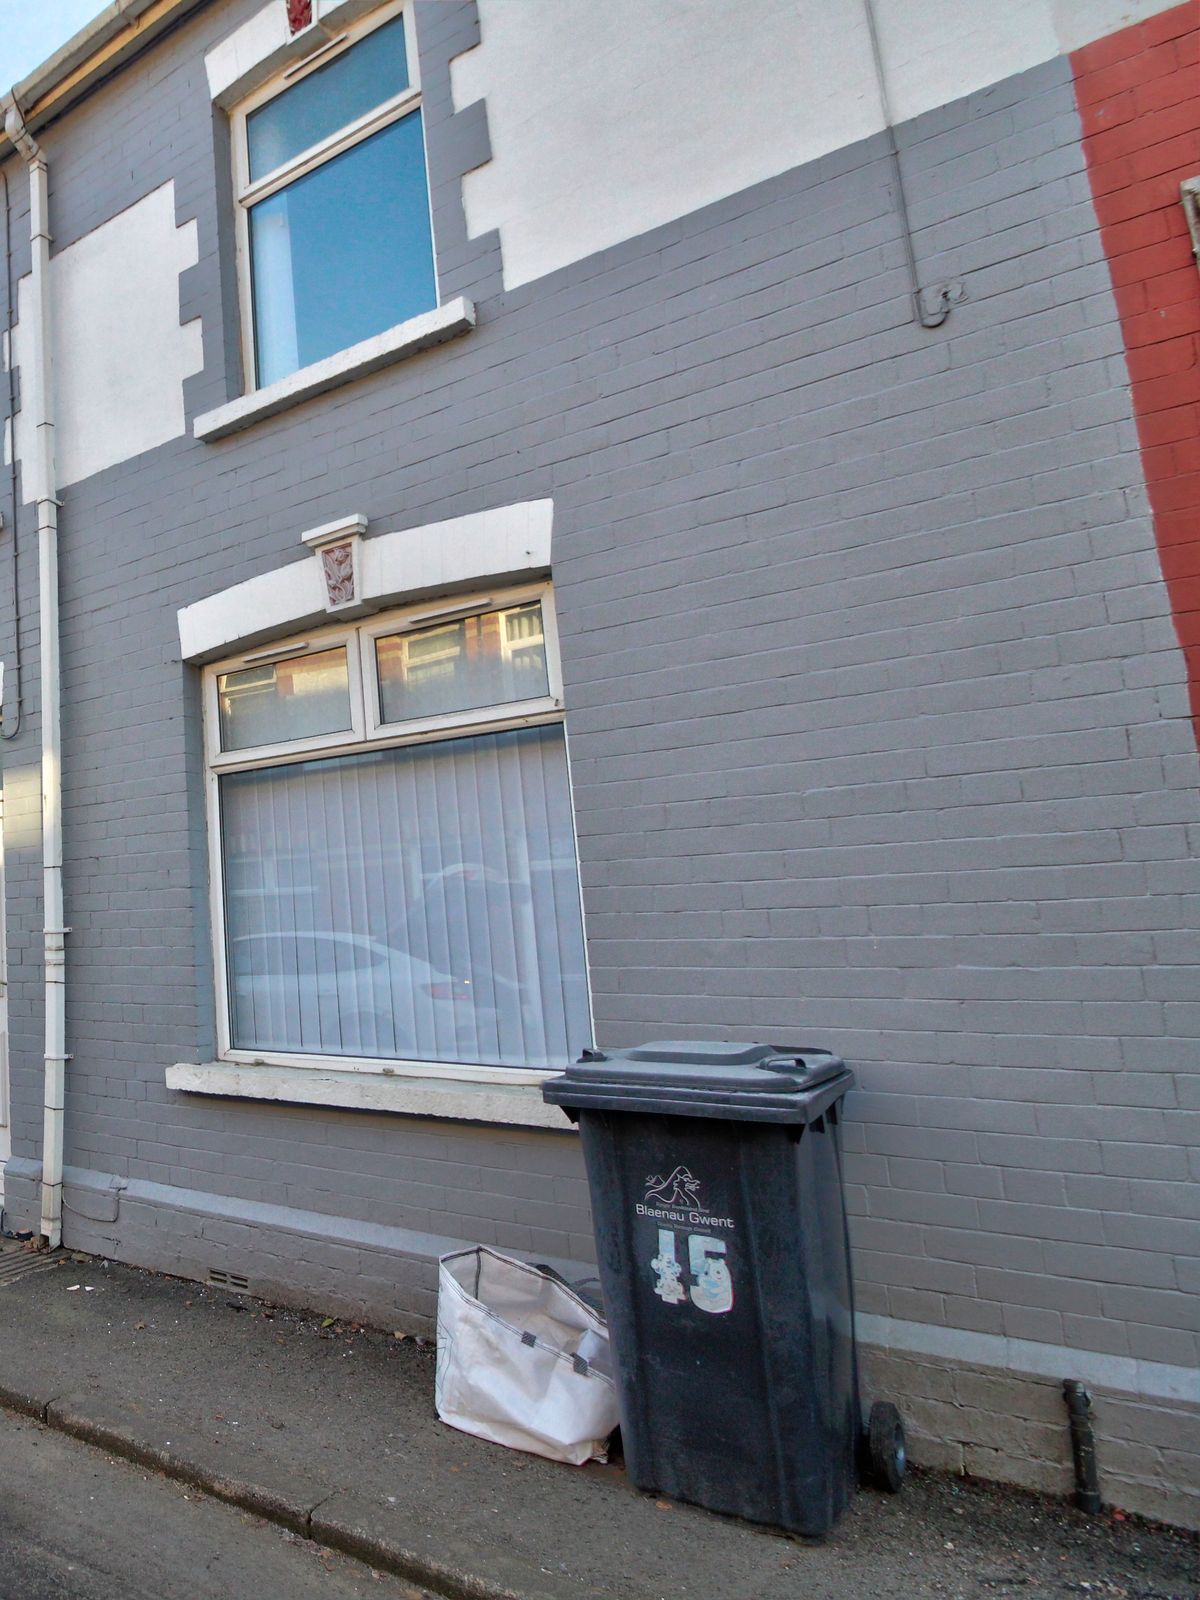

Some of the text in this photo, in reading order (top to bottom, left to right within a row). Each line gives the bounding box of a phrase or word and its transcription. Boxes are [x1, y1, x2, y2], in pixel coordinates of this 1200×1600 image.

[635, 1203, 685, 1222] Blaenau
[688, 1211, 736, 1228] Gwent
[651, 1228, 734, 1313] 15
